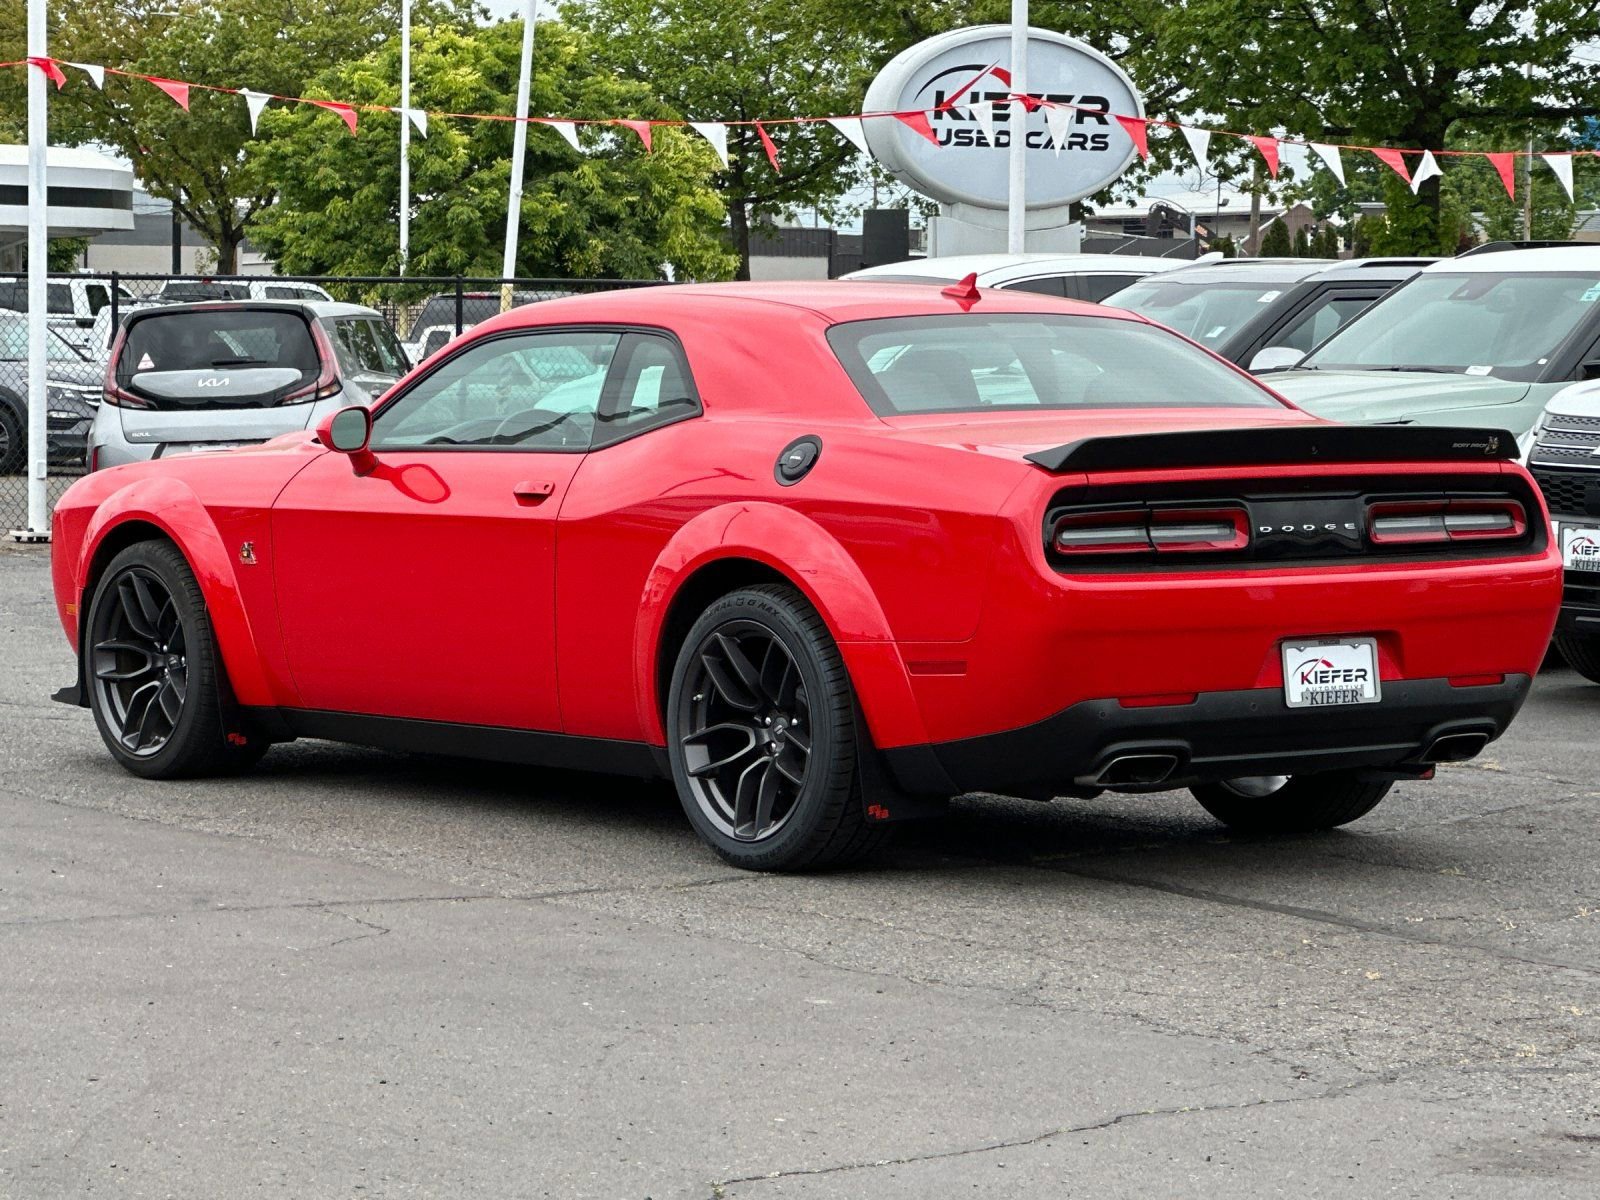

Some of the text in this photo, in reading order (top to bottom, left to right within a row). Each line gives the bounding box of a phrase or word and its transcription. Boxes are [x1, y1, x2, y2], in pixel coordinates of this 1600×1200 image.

[1260, 523, 1356, 533] DODGE
[1301, 668, 1368, 685] KIEFER
[1310, 690, 1360, 705] KIEFER
